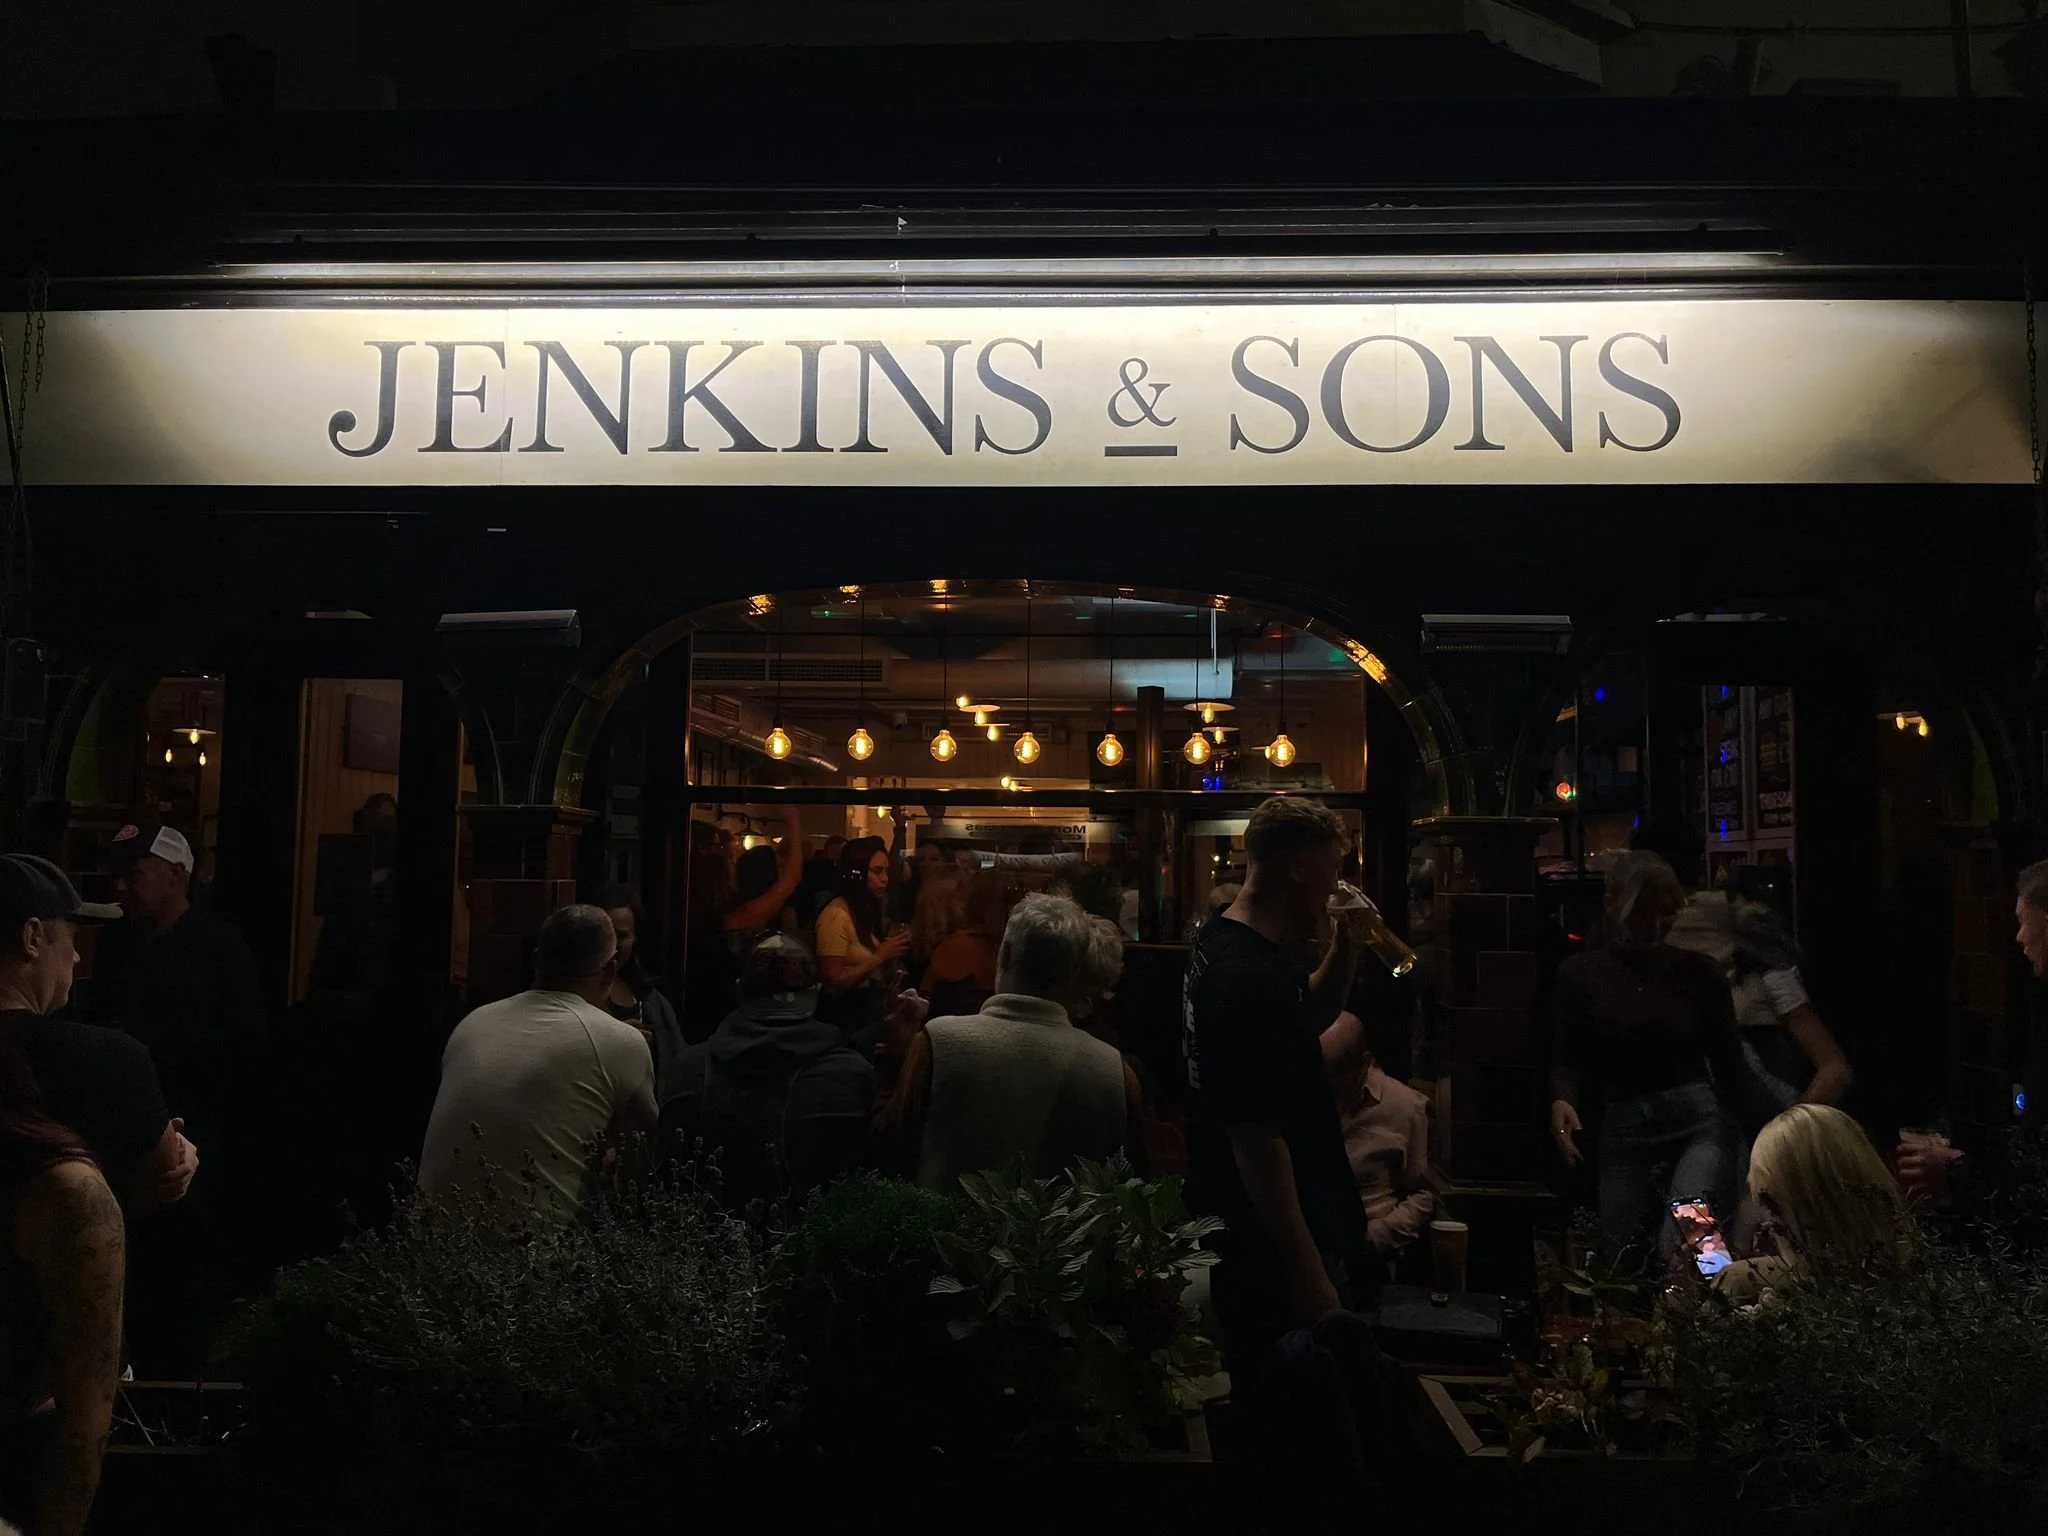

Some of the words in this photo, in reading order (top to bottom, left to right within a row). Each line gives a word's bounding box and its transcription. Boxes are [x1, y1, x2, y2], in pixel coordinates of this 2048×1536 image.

[328, 338, 1050, 458] JENKINS
[1107, 357, 1177, 428] &
[1230, 332, 1681, 456] SONS
